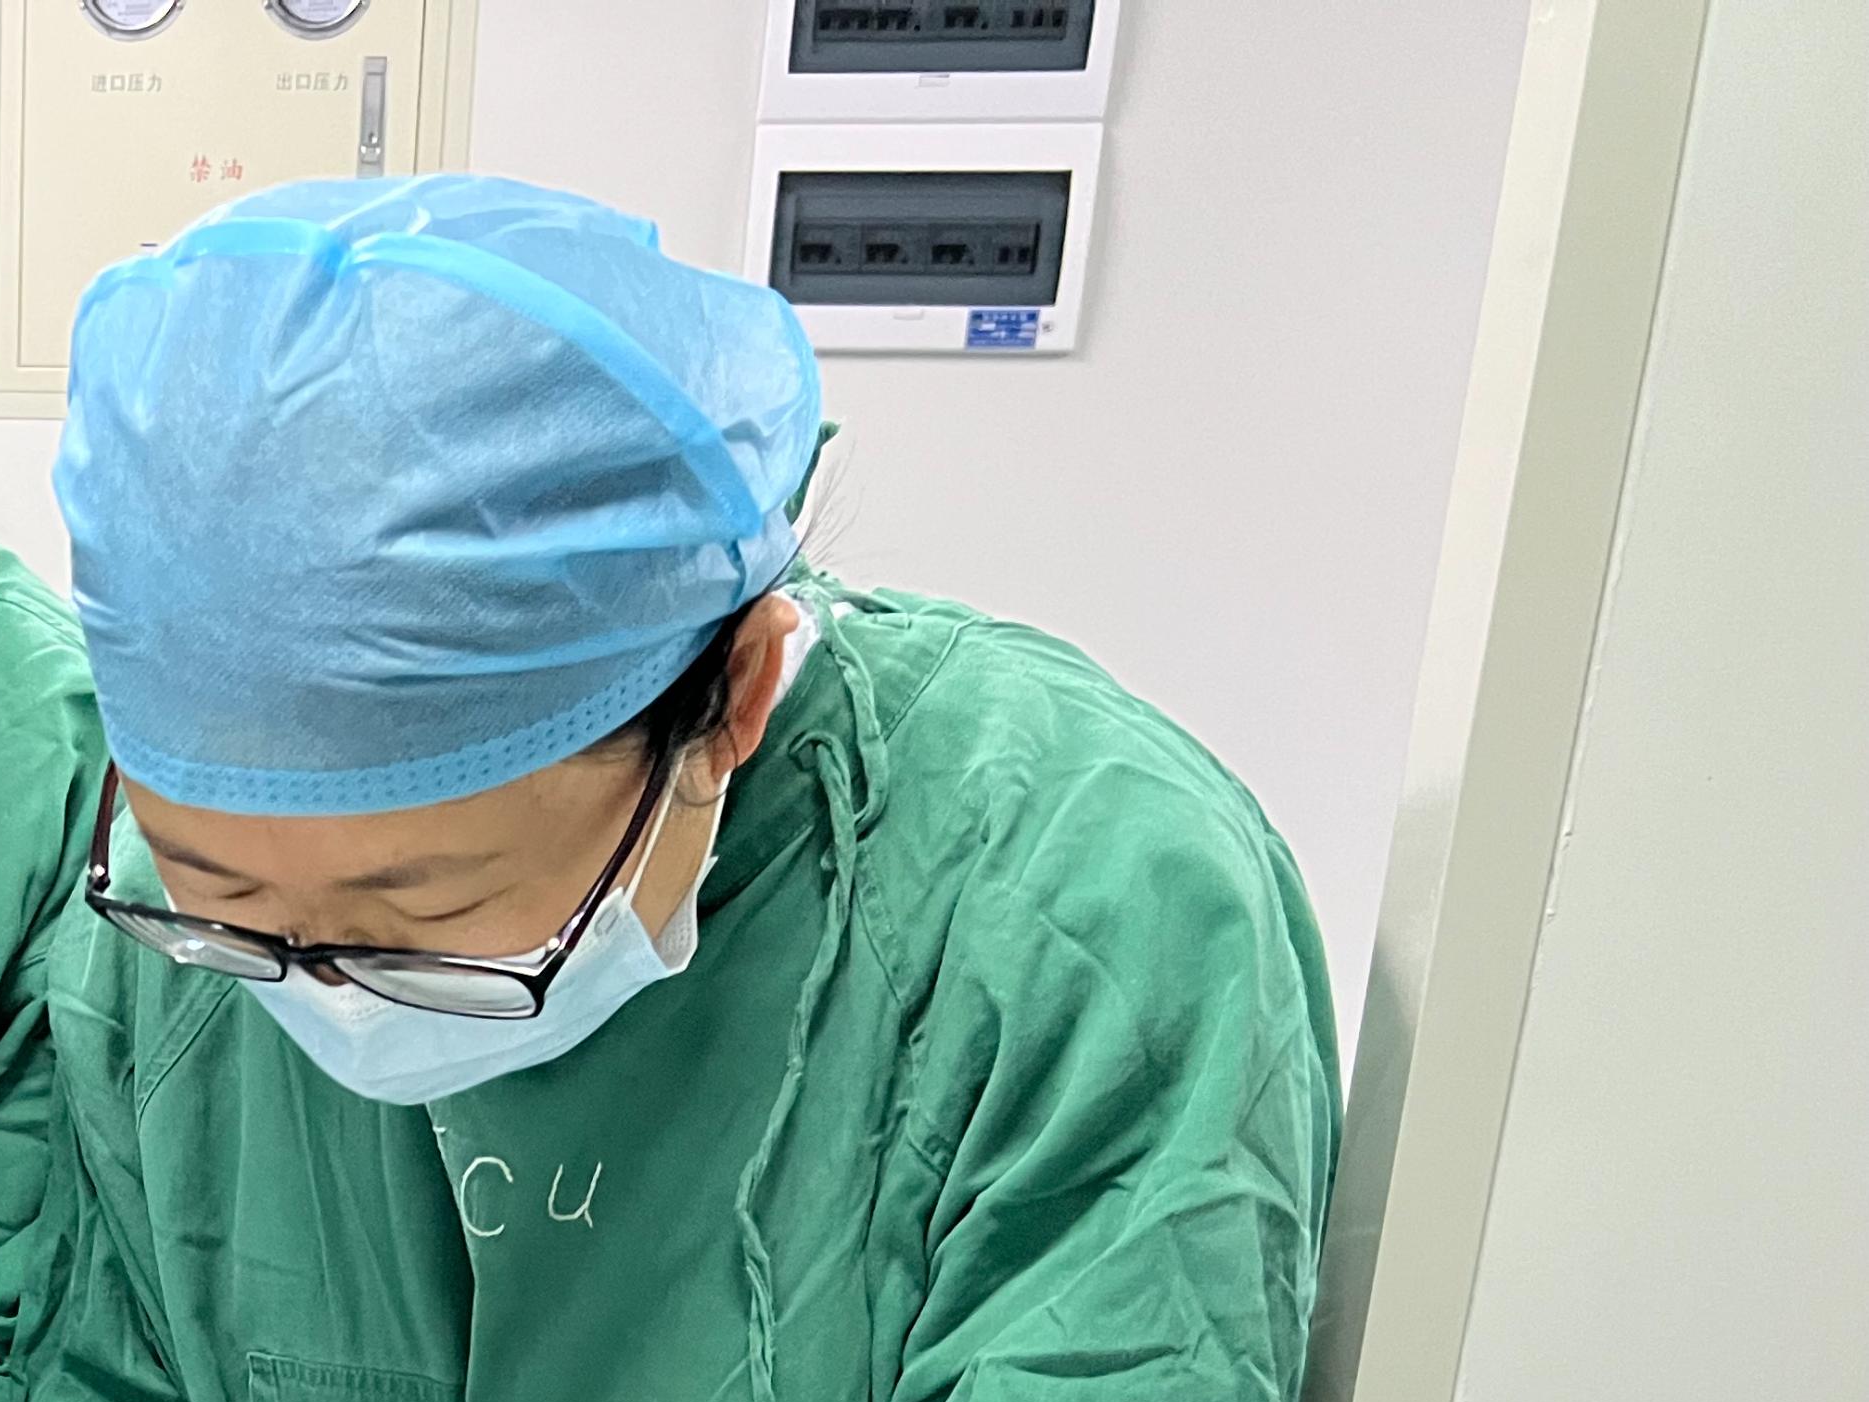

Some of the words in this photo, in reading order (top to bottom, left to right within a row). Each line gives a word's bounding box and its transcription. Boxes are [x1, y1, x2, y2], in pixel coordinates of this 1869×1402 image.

[91, 73, 163, 93] 进口压力
[276, 73, 349, 92] 出口压力
